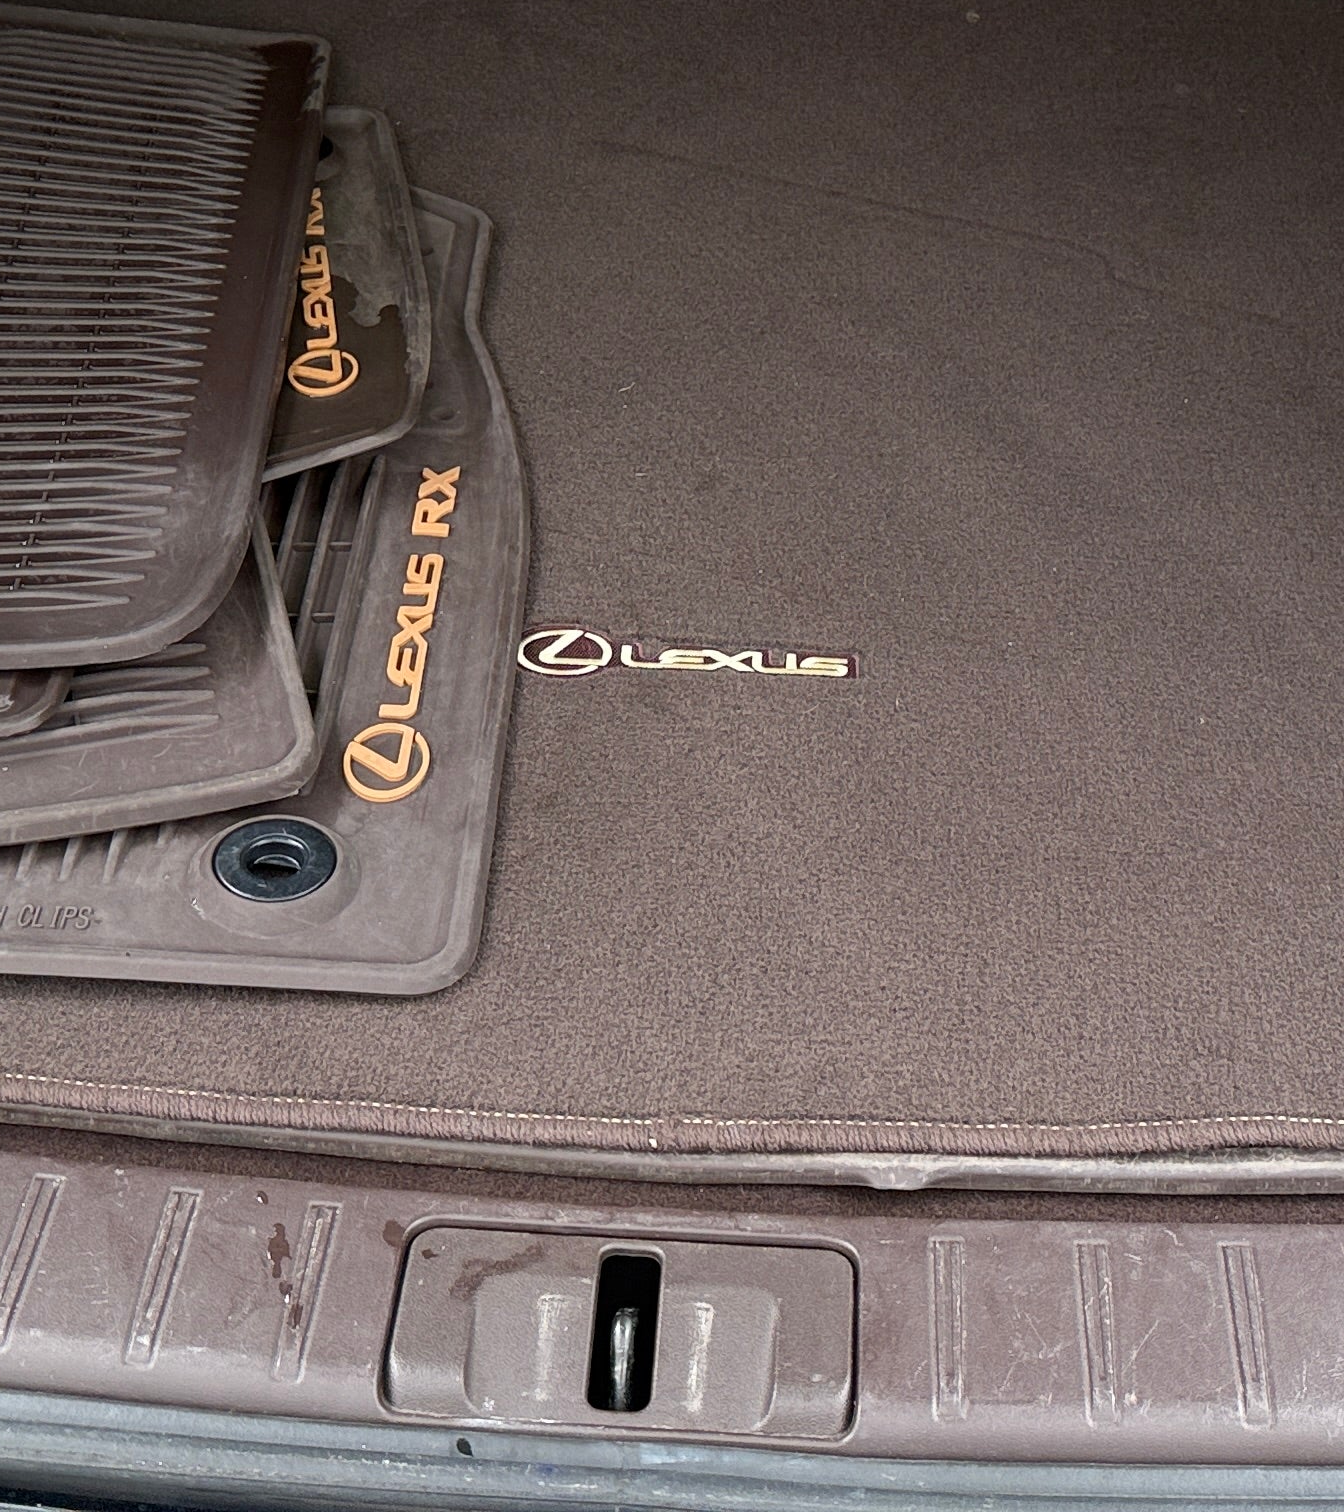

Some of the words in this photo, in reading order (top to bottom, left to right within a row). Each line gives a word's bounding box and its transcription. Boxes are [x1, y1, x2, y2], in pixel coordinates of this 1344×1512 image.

[301, 244, 338, 351] LEXUS
[378, 553, 444, 720] LEXUS
[412, 466, 461, 538] RX
[620, 644, 849, 677] LEXUS
